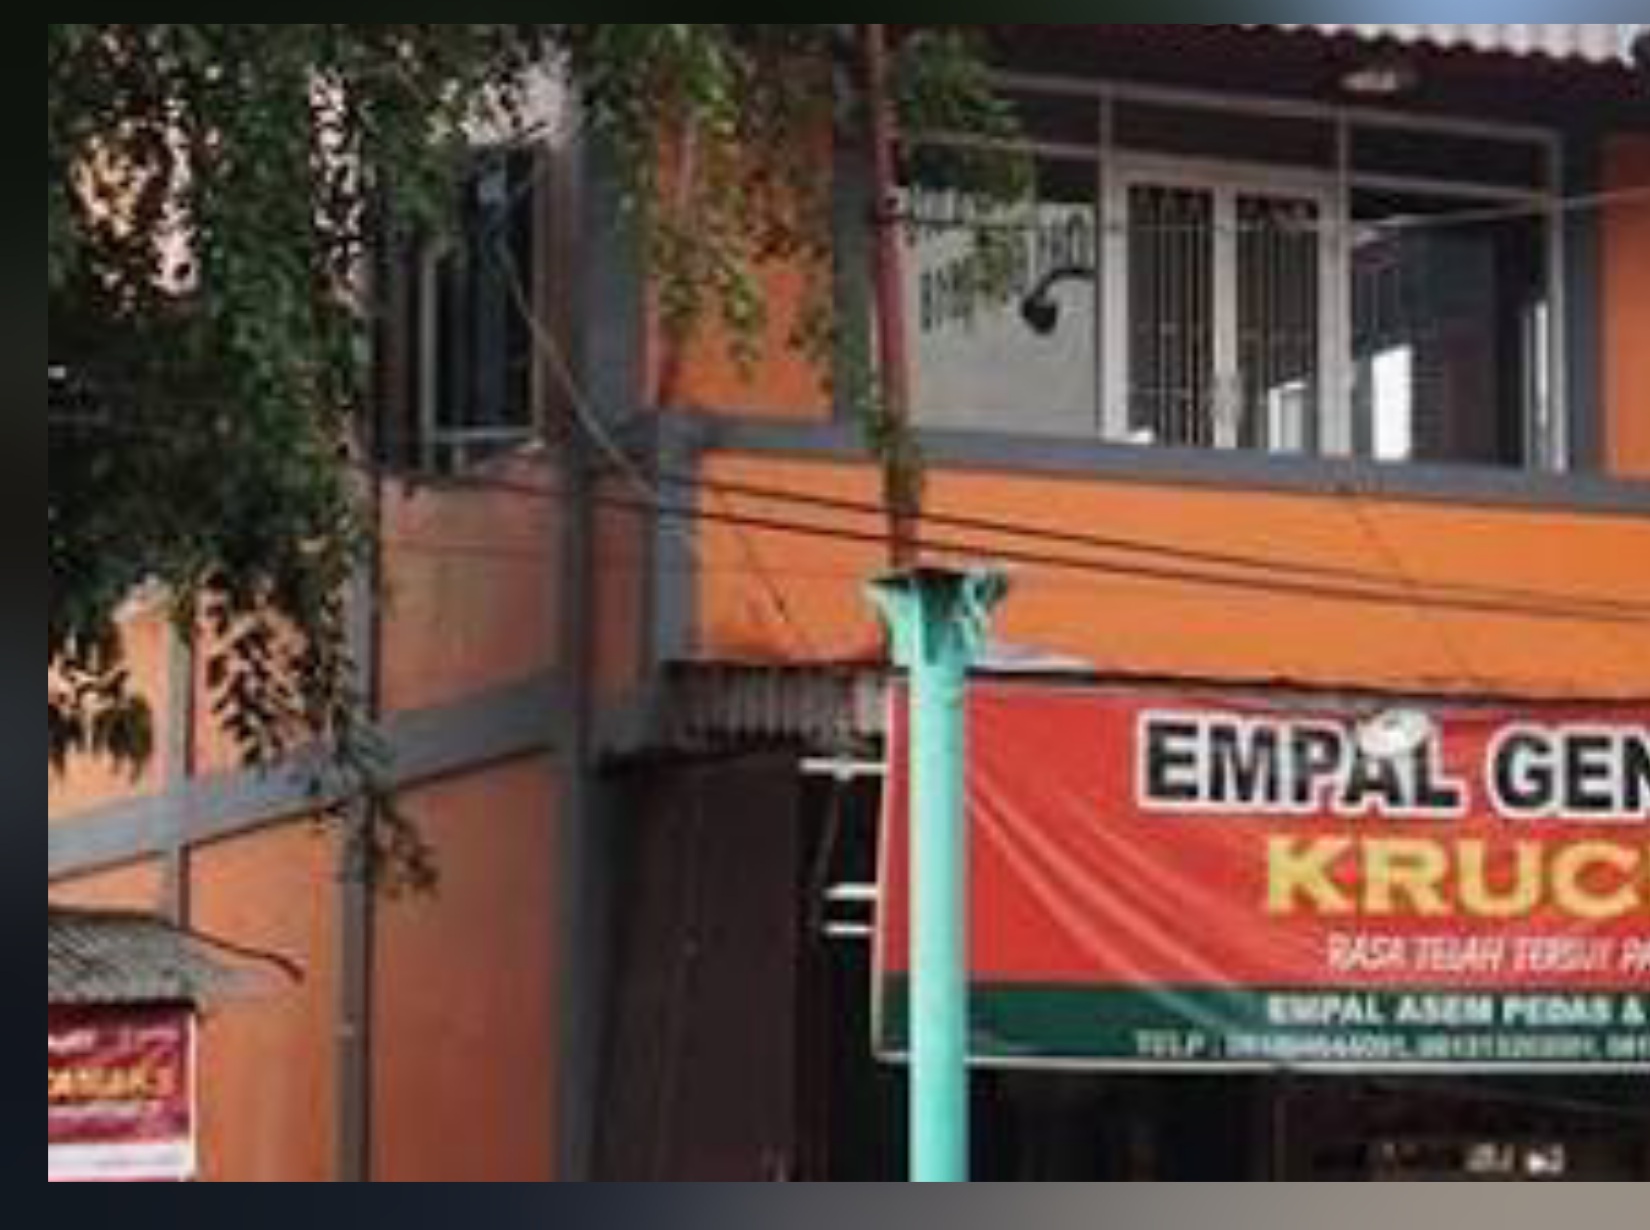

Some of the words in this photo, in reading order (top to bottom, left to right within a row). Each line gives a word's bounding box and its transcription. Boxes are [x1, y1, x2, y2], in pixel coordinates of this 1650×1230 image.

[1142, 713, 1465, 813] EMPAL
[1327, 932, 1405, 972] RASA
[1267, 994, 1384, 1026] EMPAL
[1397, 994, 1494, 1026] ASEM
[1503, 994, 1613, 1026] PEDAS
[1621, 994, 1646, 1026] &
